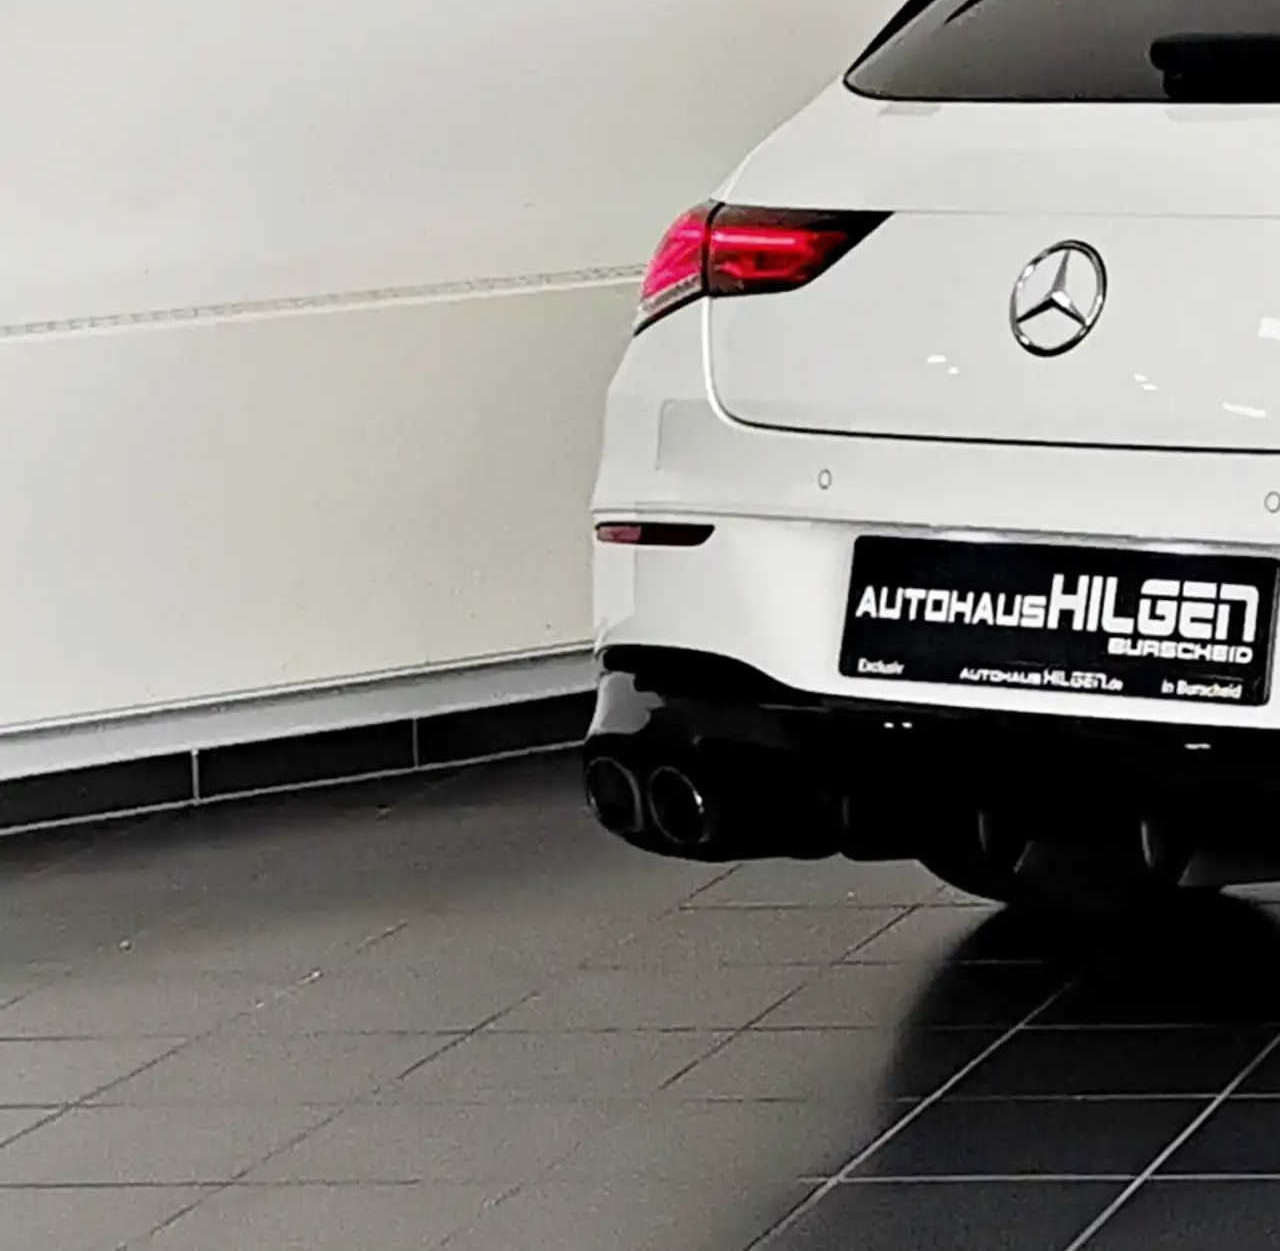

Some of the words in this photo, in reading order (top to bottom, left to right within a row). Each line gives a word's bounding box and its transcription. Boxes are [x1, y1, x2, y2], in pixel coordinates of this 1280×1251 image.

[856, 585, 1046, 629] AUTOHAUS
[1047, 573, 1259, 642] HILGEN
[1107, 638, 1254, 664] BURSCHEID
